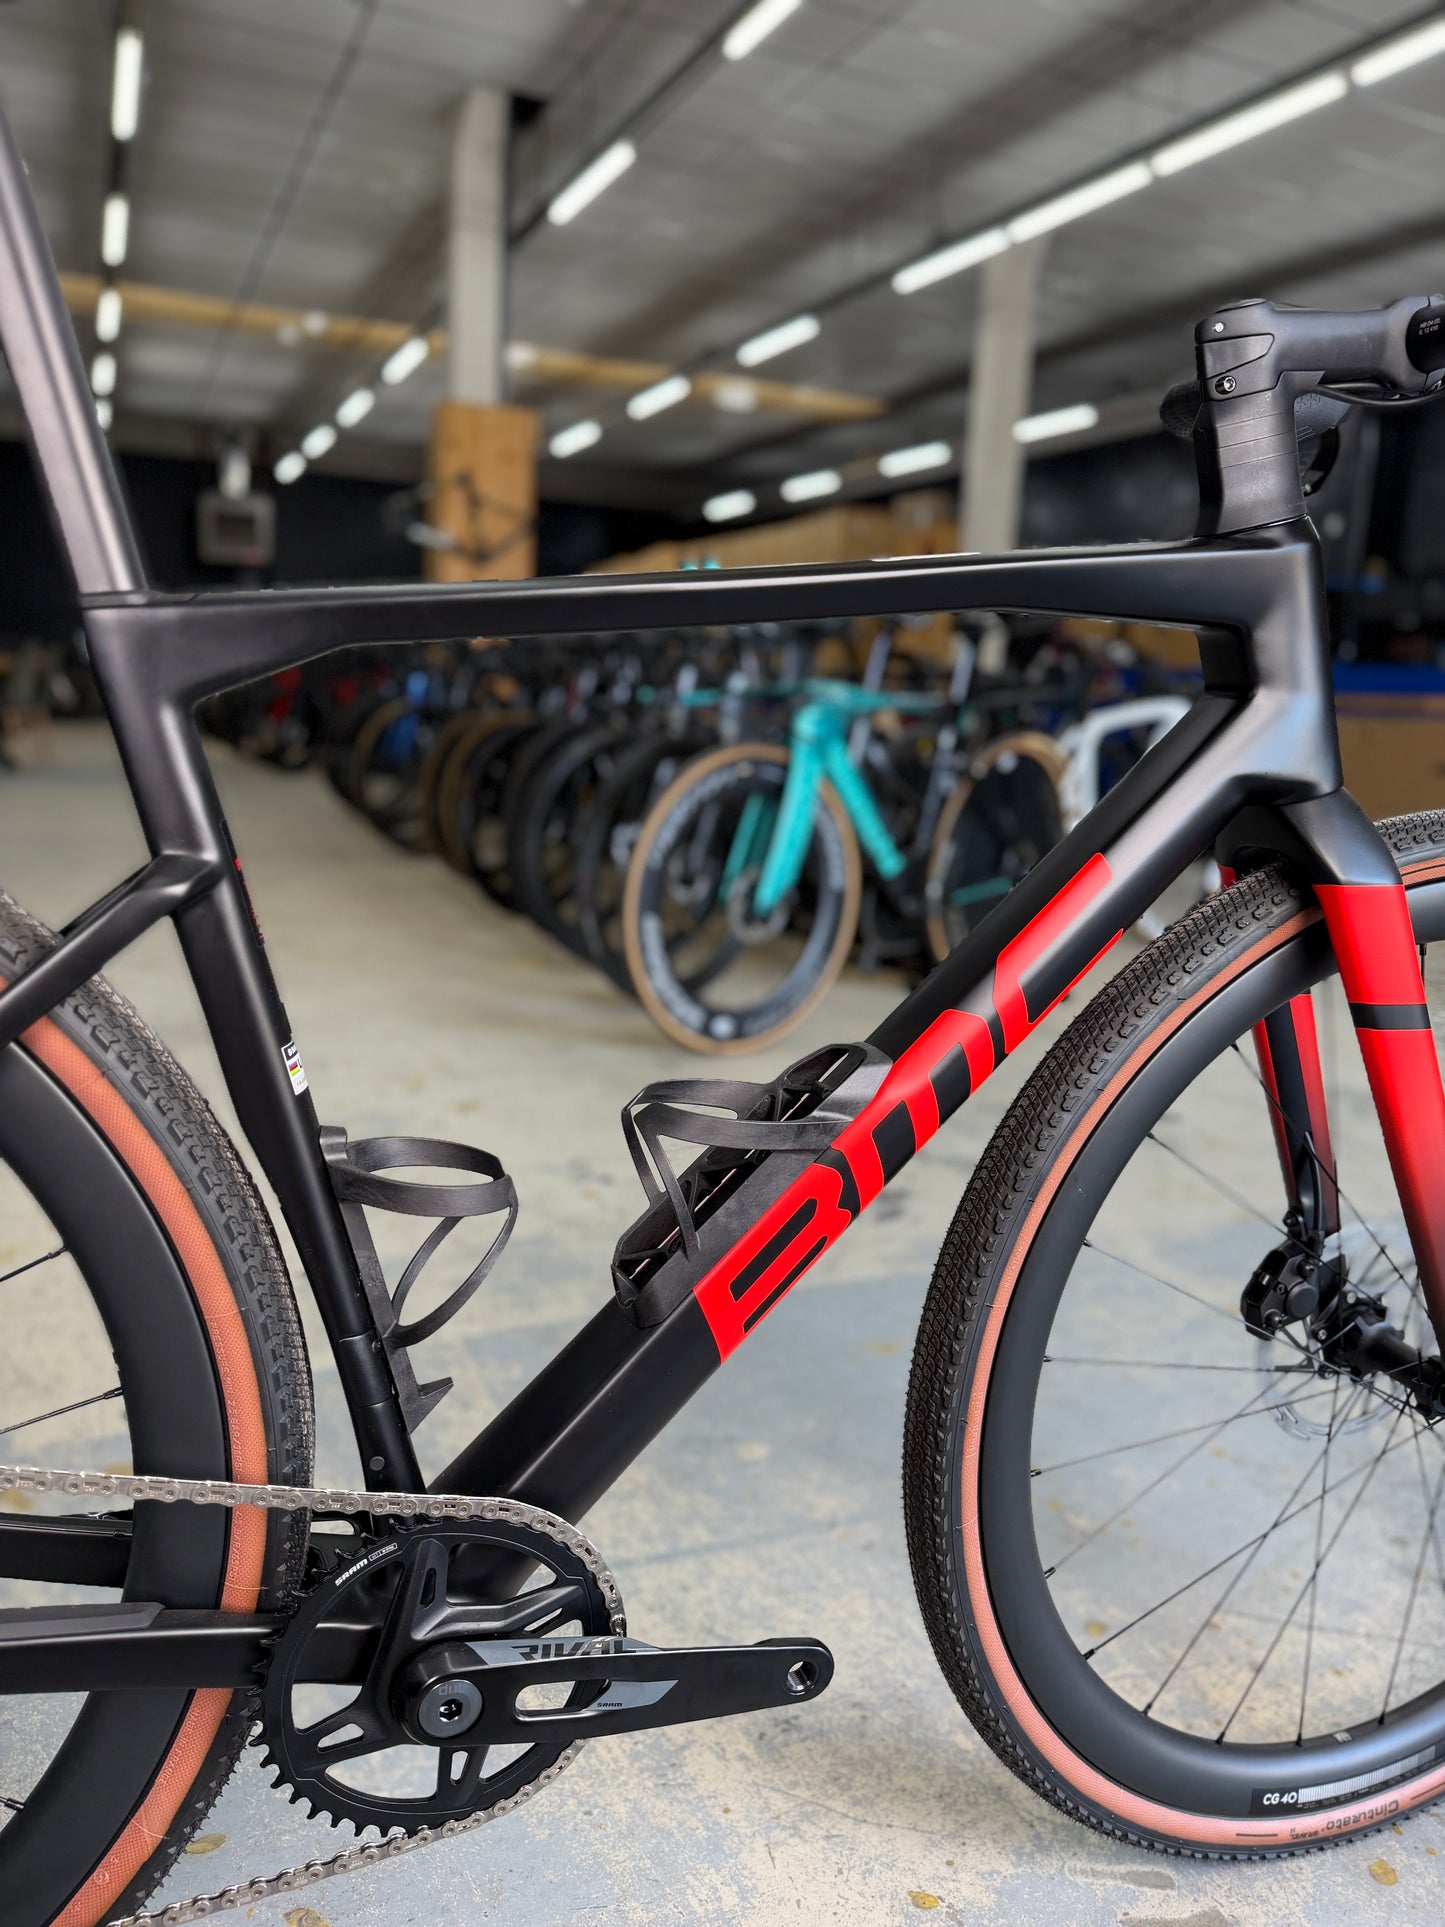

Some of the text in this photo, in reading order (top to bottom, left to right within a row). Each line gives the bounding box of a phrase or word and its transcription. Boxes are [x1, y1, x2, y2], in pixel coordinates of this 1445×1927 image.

[693, 852, 1123, 1366] BMC
[335, 1558, 368, 1587] SRAM
[511, 1639, 637, 1662] RIVAL
